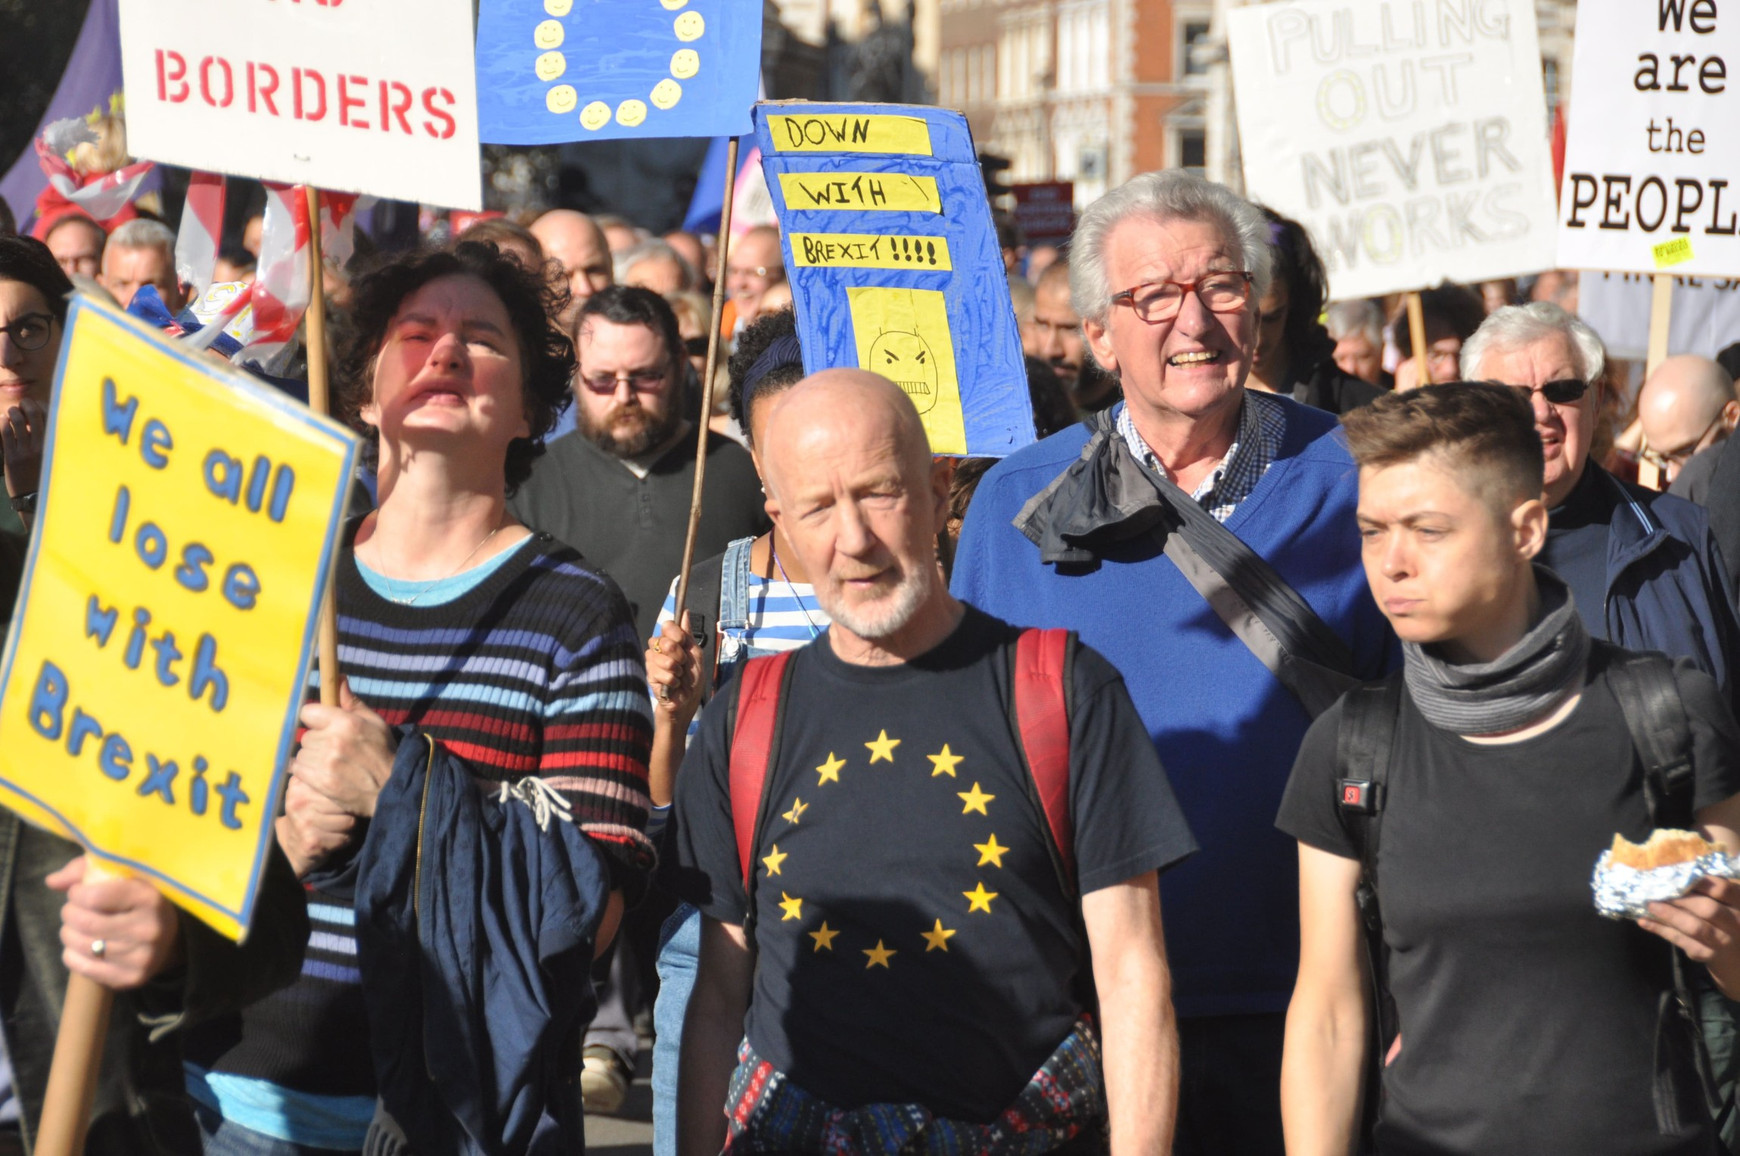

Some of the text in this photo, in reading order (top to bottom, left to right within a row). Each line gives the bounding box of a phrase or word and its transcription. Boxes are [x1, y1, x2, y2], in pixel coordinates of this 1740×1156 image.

[1267, 0, 1511, 76] PULLING
[1658, 0, 1718, 34] We
[155, 49, 457, 140] BORDERS
[1315, 52, 1474, 132] OUT
[1633, 52, 1727, 94] are
[785, 117, 870, 148] DOWN
[1302, 115, 1523, 210] NEVER
[1645, 117, 1706, 154] the
[799, 175, 887, 207] WITH
[1320, 182, 1531, 272] WORKS
[1566, 173, 1740, 236] PEOPL
[803, 235, 881, 264] BREXIT
[203, 448, 295, 523] all
[108, 485, 262, 611] lose
[84, 594, 229, 713] with
[27, 659, 250, 831] Brexit
